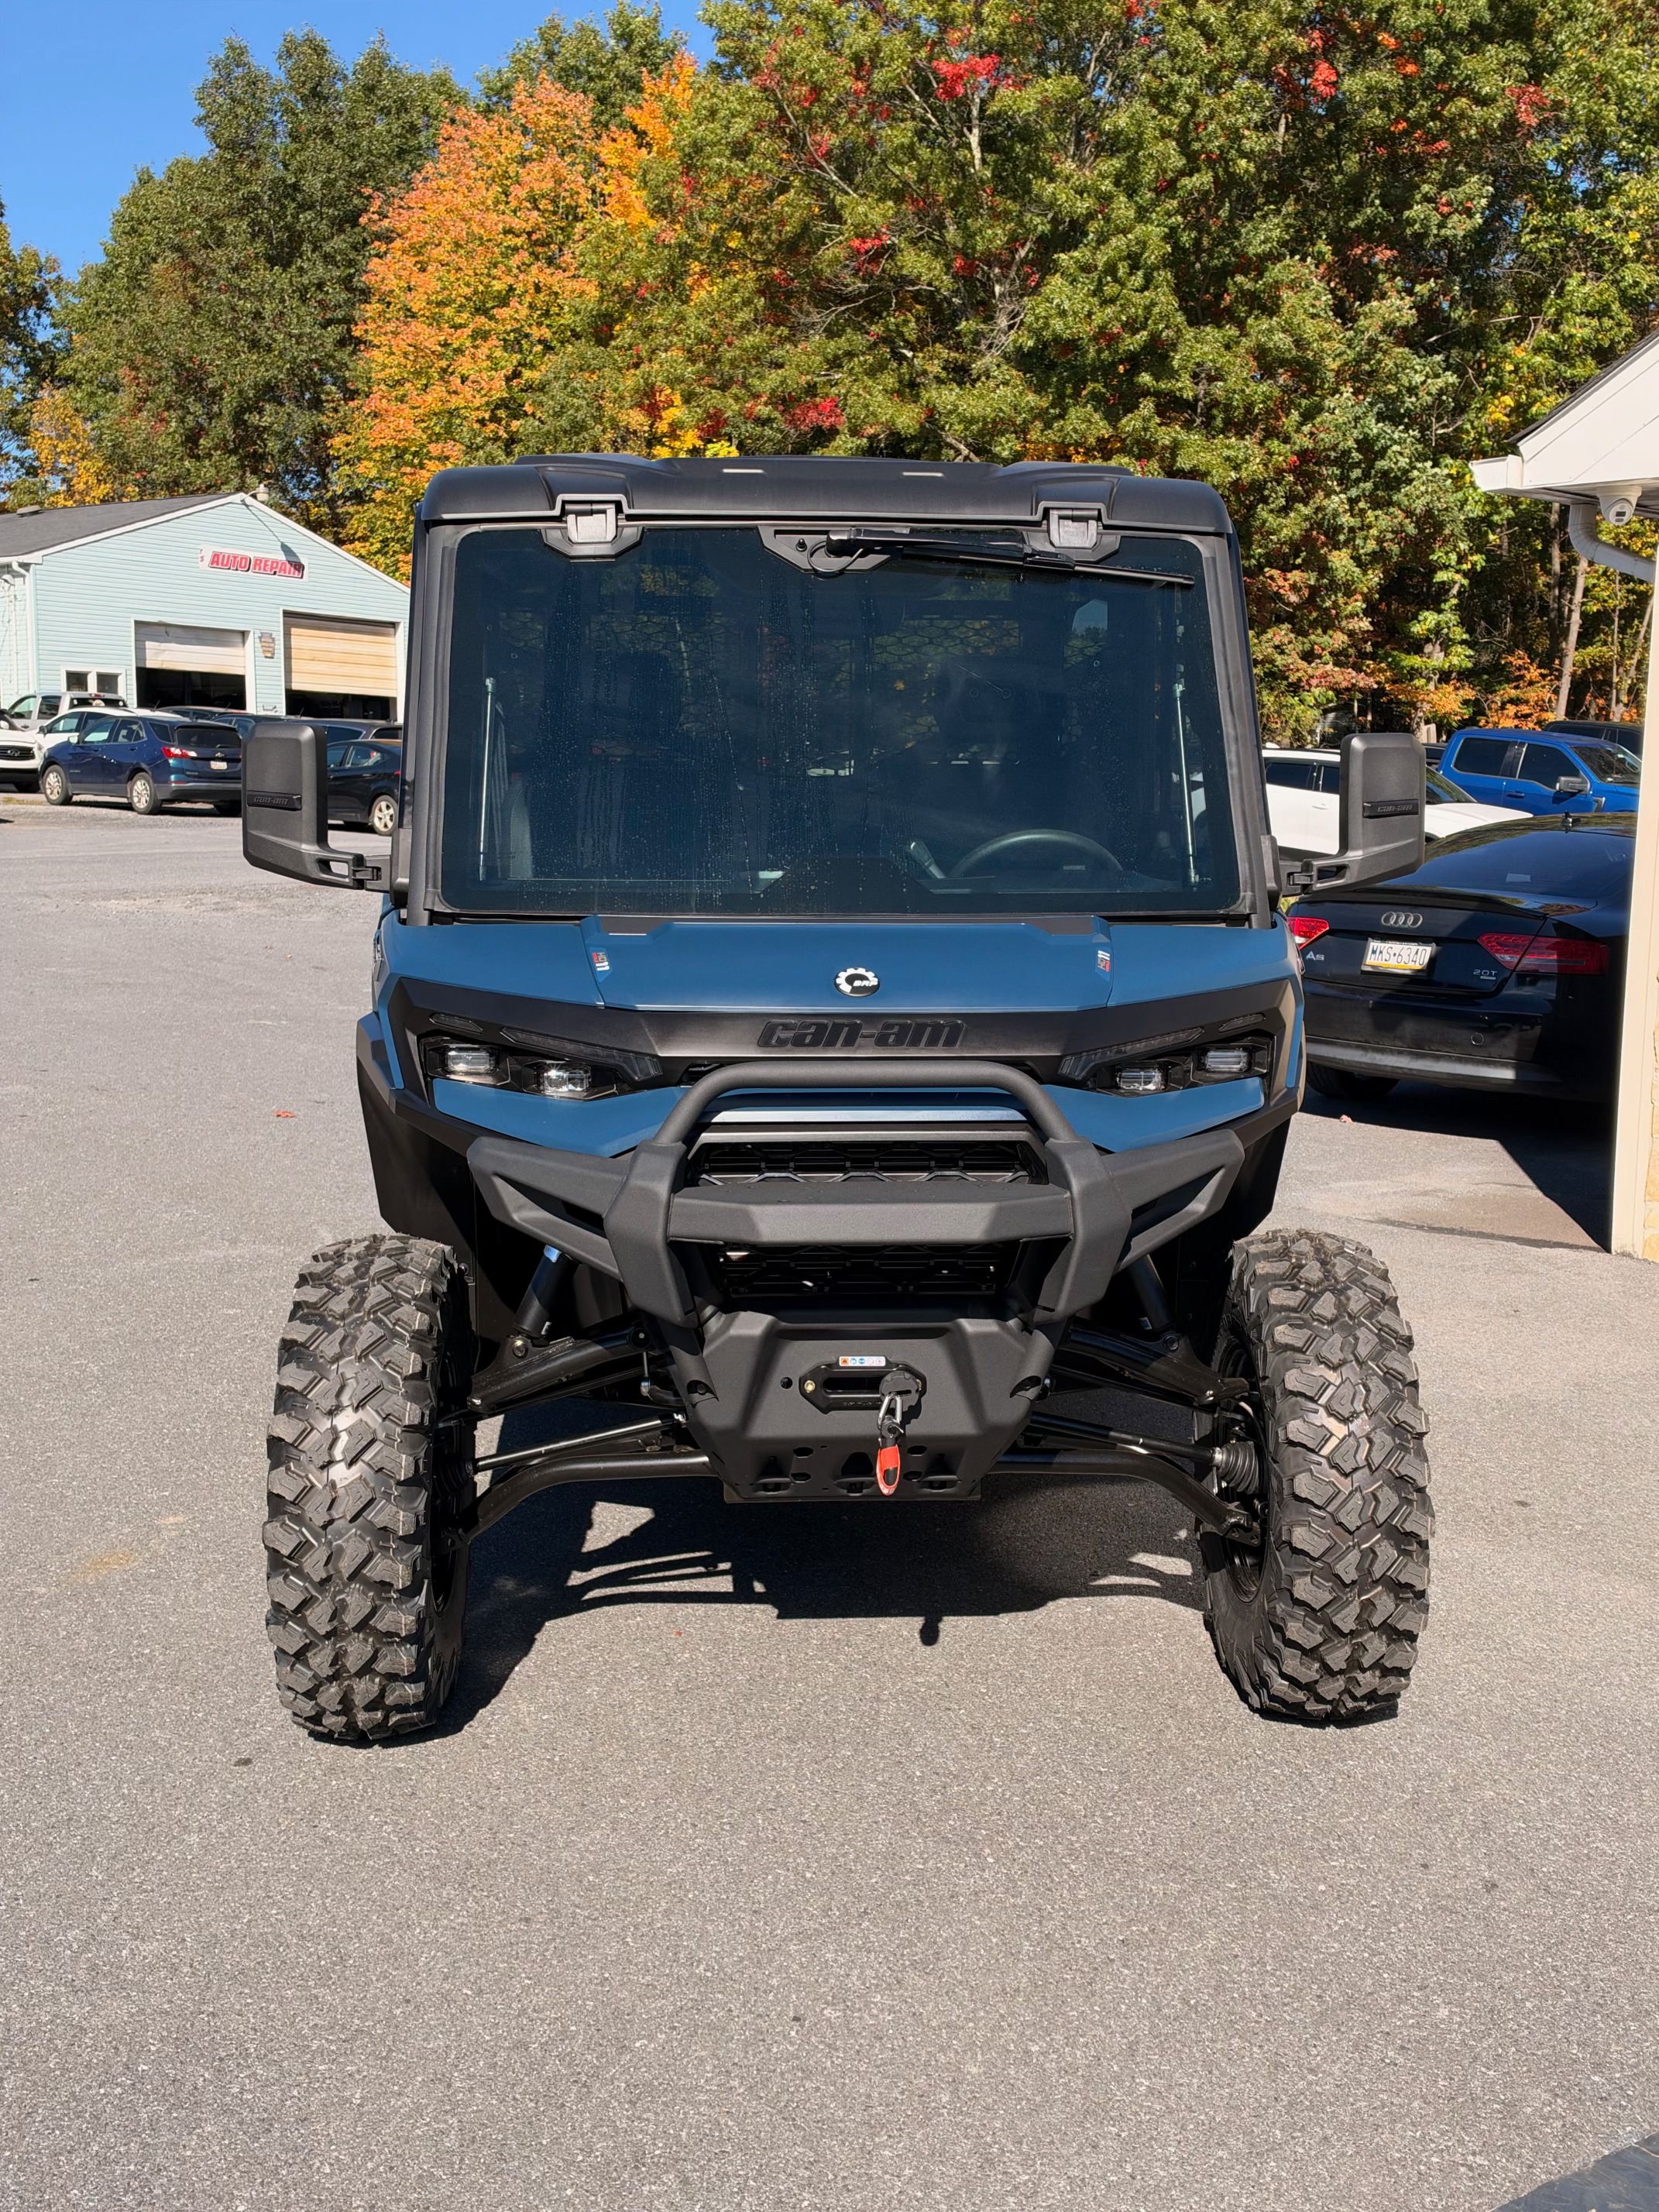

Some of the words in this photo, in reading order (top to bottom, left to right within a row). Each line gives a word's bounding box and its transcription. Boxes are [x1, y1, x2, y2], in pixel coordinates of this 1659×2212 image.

[209, 551, 251, 572] AUTO
[252, 557, 304, 579] REPAIR
[757, 1019, 966, 1047] can-am
